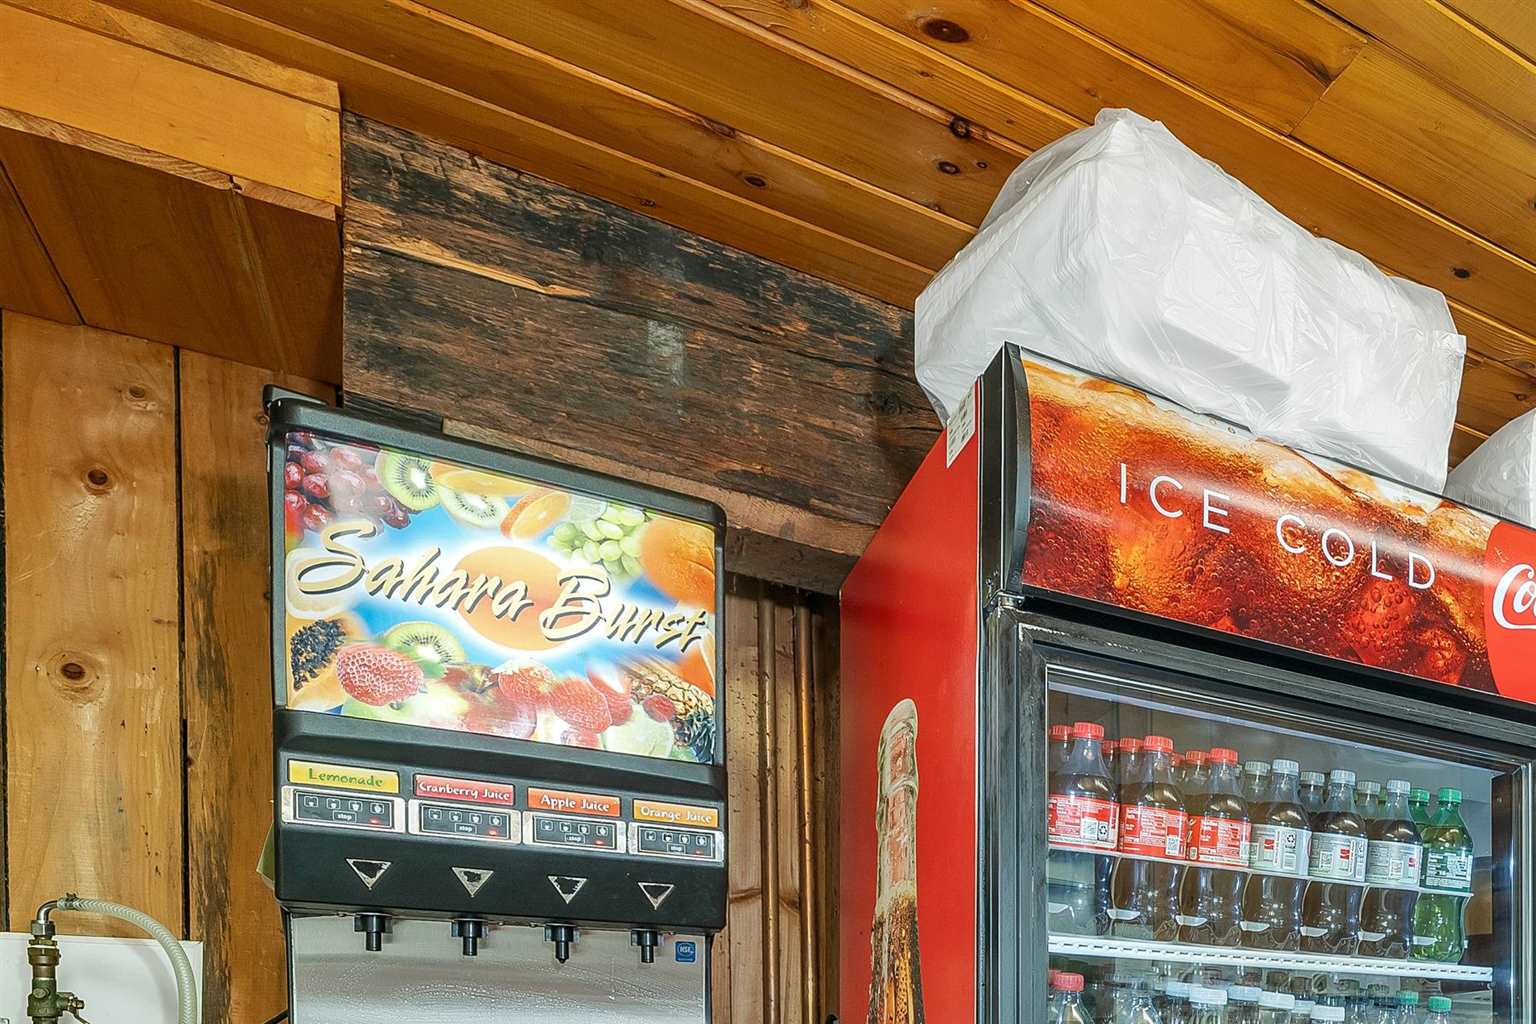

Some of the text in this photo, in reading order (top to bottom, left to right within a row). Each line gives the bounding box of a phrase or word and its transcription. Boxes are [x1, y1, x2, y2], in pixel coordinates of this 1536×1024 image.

[1119, 462, 1437, 590] ICE COLD
[296, 519, 707, 654] Sahara Burst
[308, 767, 384, 787] Lemonade
[418, 779, 511, 802] Cranberry Juice
[540, 793, 611, 812] Apple Juice
[640, 804, 713, 824] Orange Juice
